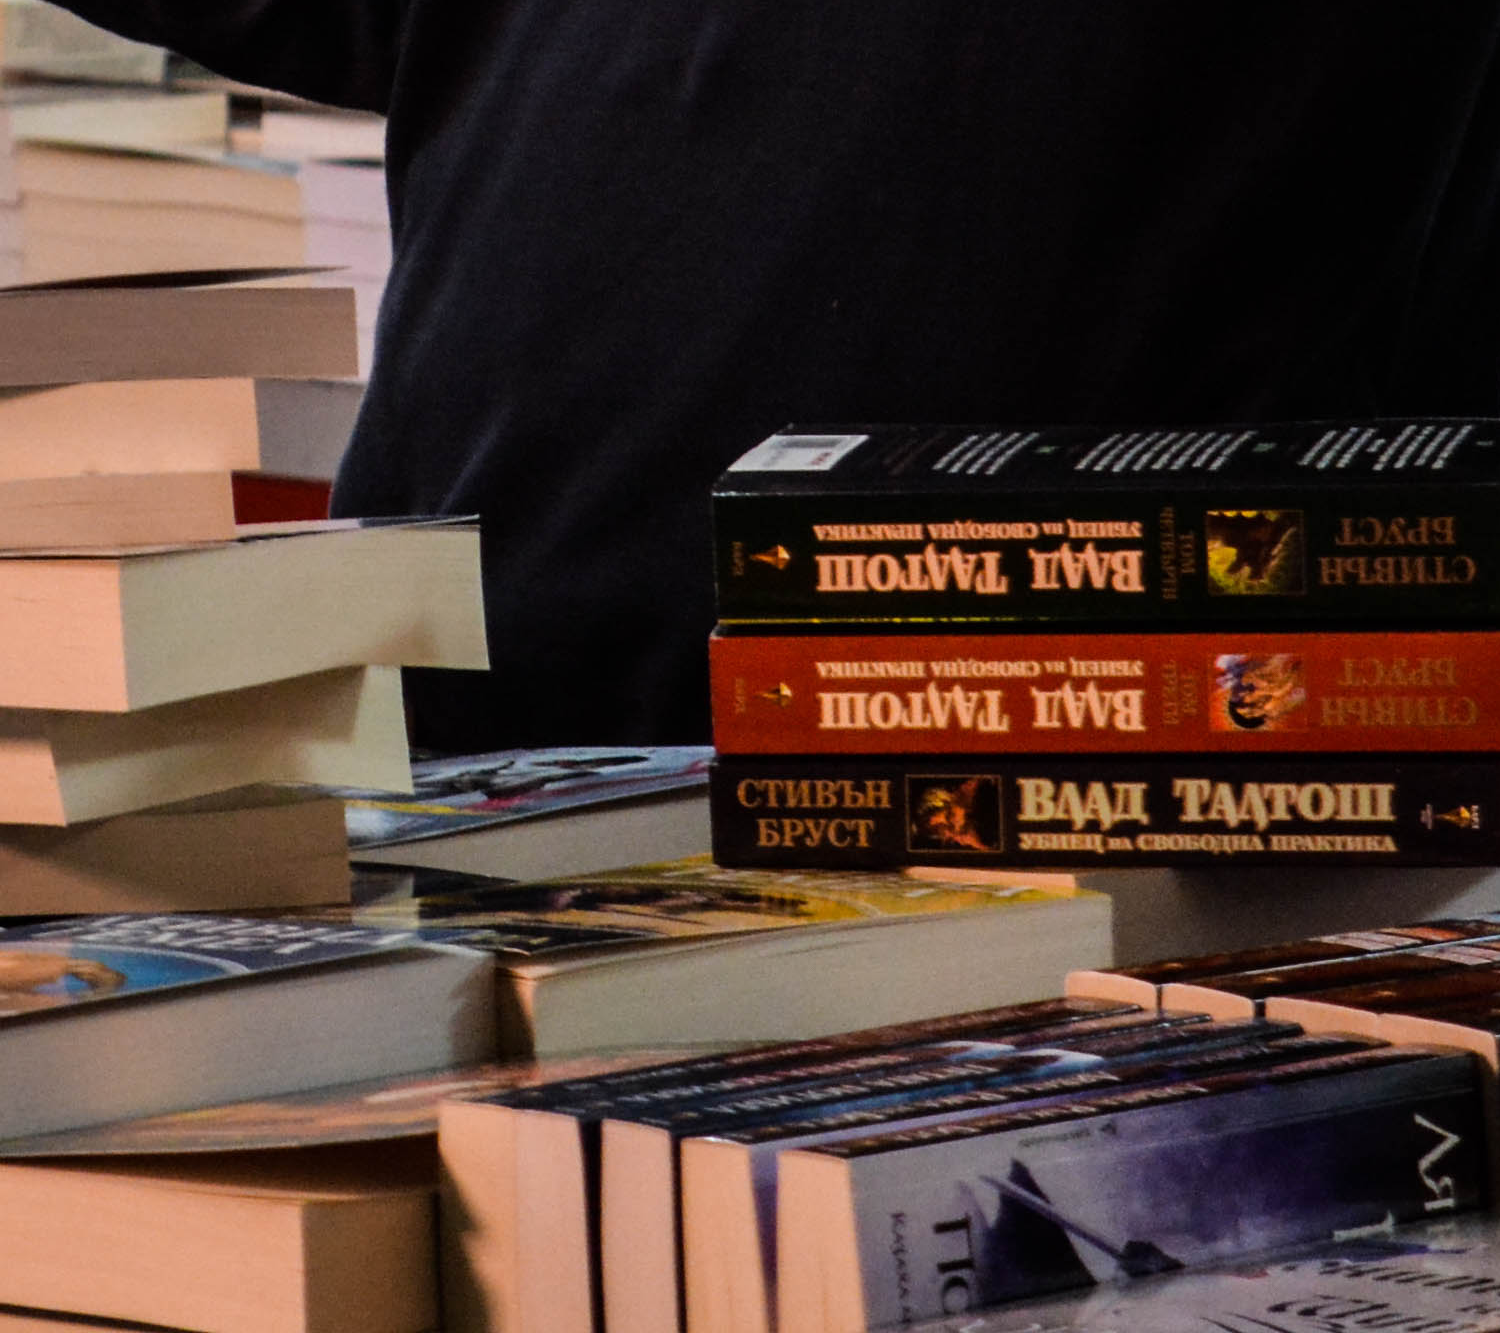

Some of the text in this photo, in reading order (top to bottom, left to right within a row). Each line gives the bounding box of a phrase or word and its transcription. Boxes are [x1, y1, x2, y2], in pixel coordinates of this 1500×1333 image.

[812, 520, 923, 542] ПРАКТИКА
[928, 519, 1039, 543] СВОБОДНА
[1067, 519, 1145, 543] УБИЕЦ
[1333, 513, 1457, 548] БРУСТ
[815, 542, 1146, 597] ВЛАД ТАЛТОШ
[1319, 552, 1477, 587] СТИВЪН
[815, 659, 926, 680] ПРАКТИКА
[929, 658, 1040, 680] СВОБОДНА
[1067, 658, 1145, 680] УБИЕЦ
[1333, 655, 1457, 687] БРУСТ
[817, 686, 1147, 734] ВЛАД ТАЛТОШ
[1320, 694, 1478, 728] СТИВЪН
[735, 776, 893, 812] СТИВЪН
[1016, 776, 1397, 825] ВЛАД ТАЛТОШ
[755, 816, 876, 850] БРУСТ
[1018, 830, 1104, 855] УБИЕЦ
[1136, 829, 1266, 855] СВОБОДНА
[1269, 832, 1399, 854] ПРАКТИКА
[1412, 1109, 1462, 1213] ЛЯ
[932, 1216, 974, 1315] ПО
